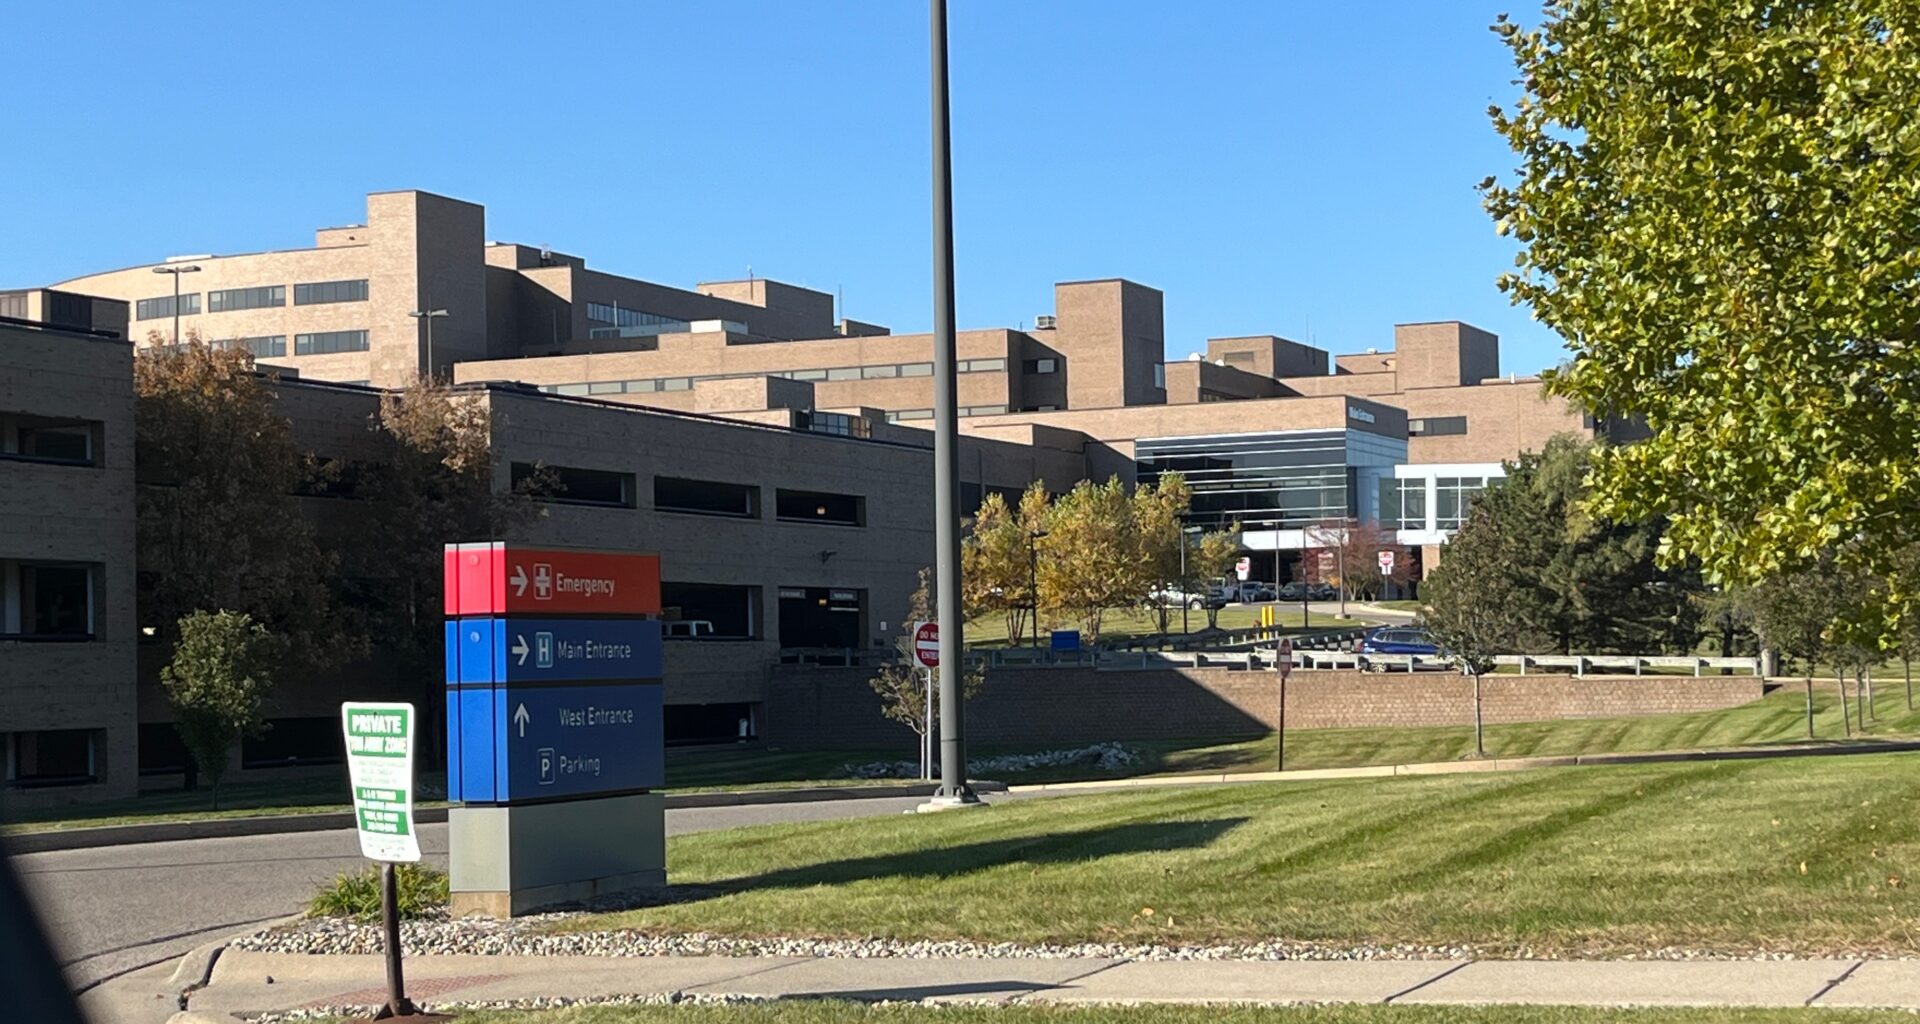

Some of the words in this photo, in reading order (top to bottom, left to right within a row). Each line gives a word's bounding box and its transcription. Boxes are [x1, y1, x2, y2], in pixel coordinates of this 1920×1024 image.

[556, 573, 616, 597] Emergency
[538, 638, 550, 662] H
[557, 640, 583, 659] Main
[586, 640, 632, 659] Entrance
[351, 714, 402, 734] PRIVATE
[559, 707, 586, 726] West
[588, 706, 634, 726] Entrance
[541, 758, 550, 778] P
[559, 755, 601, 776] Parking
